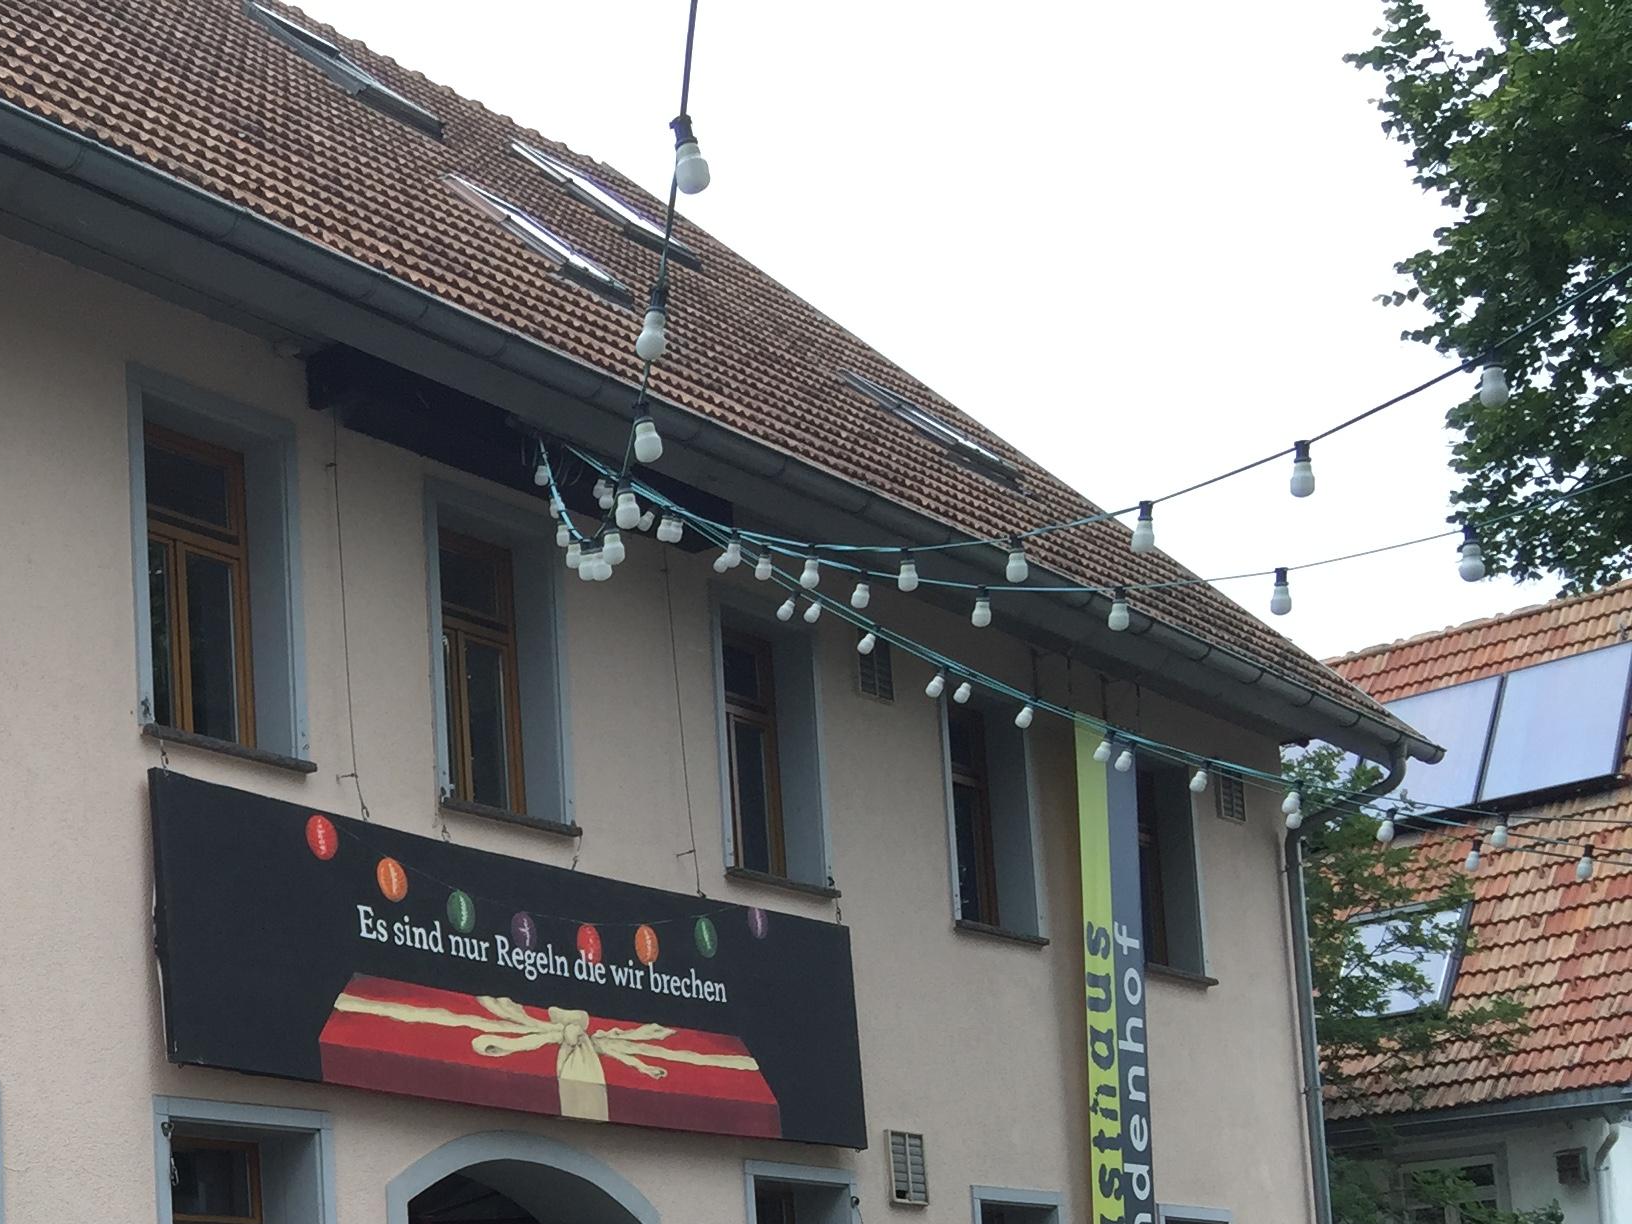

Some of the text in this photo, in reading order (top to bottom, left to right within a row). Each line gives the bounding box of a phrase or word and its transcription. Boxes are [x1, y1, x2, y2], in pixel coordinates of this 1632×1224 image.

[356, 904, 728, 1004] Es sind nur Regeln die wir brechen
